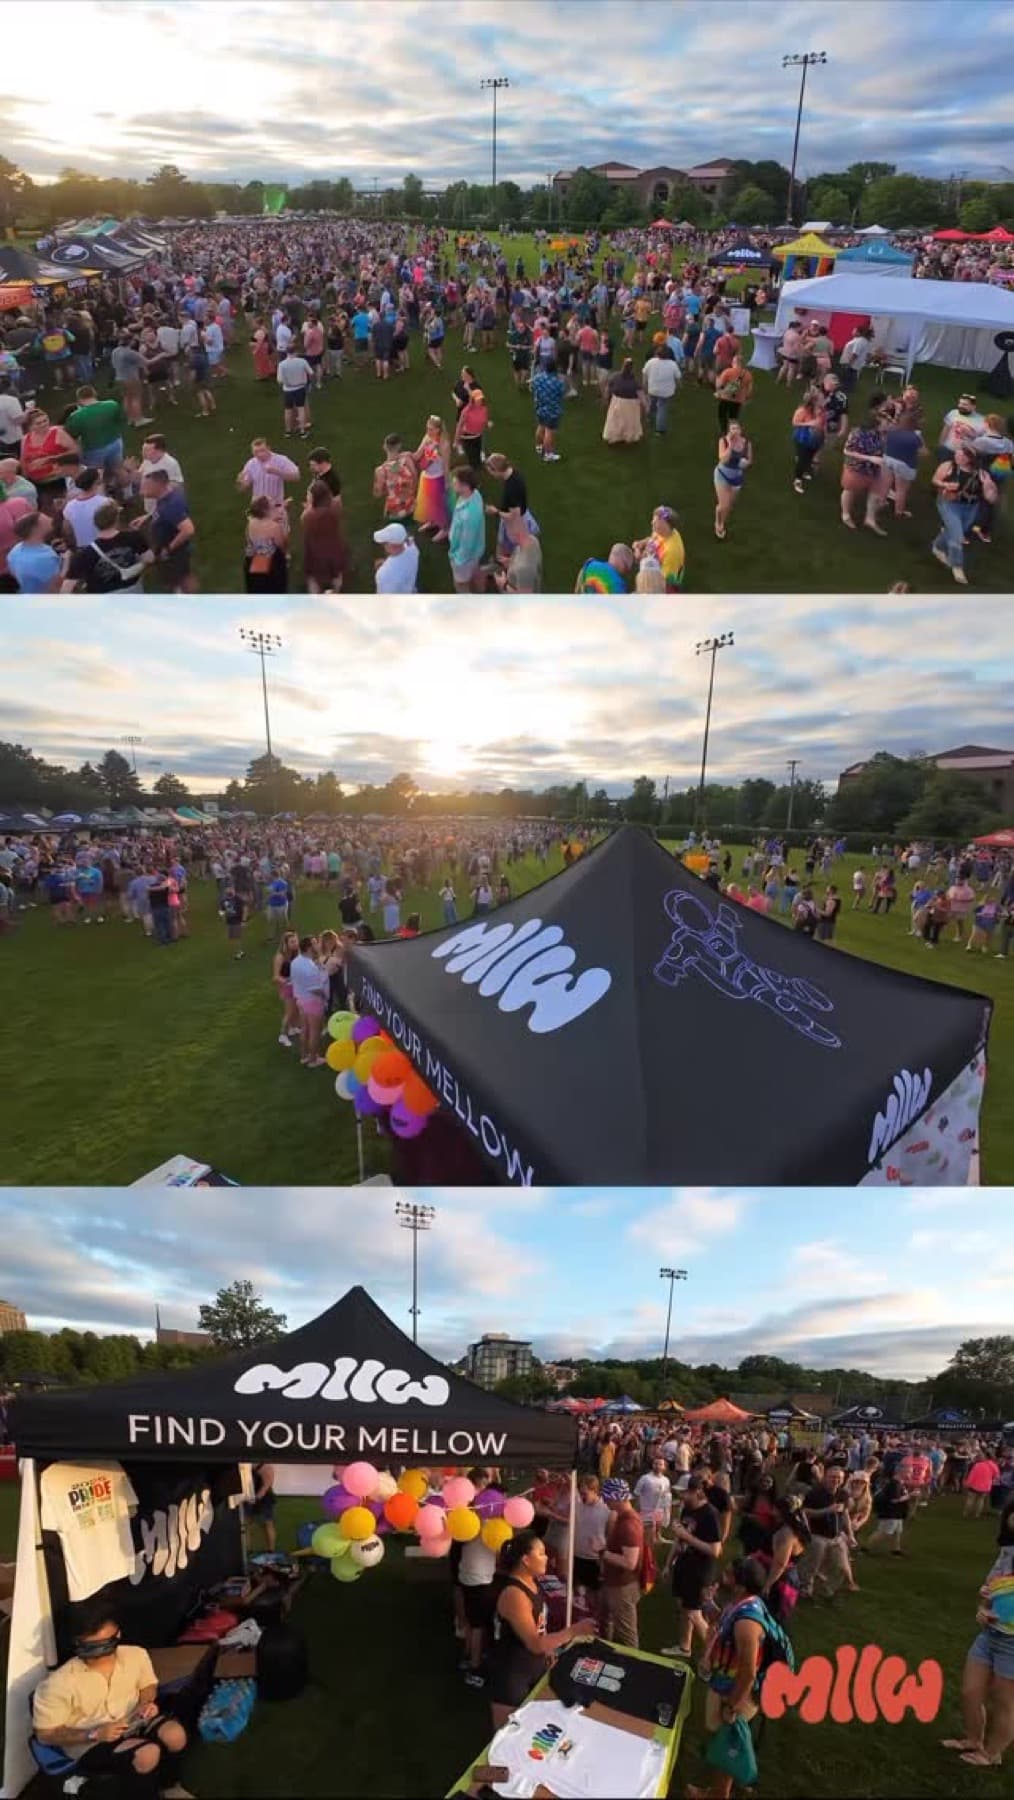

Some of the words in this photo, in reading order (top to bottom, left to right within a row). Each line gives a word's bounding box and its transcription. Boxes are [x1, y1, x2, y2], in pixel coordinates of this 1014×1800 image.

[361, 976, 383, 1014] FIND
[385, 1005, 422, 1065] YOUR
[426, 1048, 534, 1187] MELLOW
[127, 1414, 226, 1447] FIND
[237, 1420, 348, 1452] YOUR
[358, 1426, 508, 1456] MELLOW
